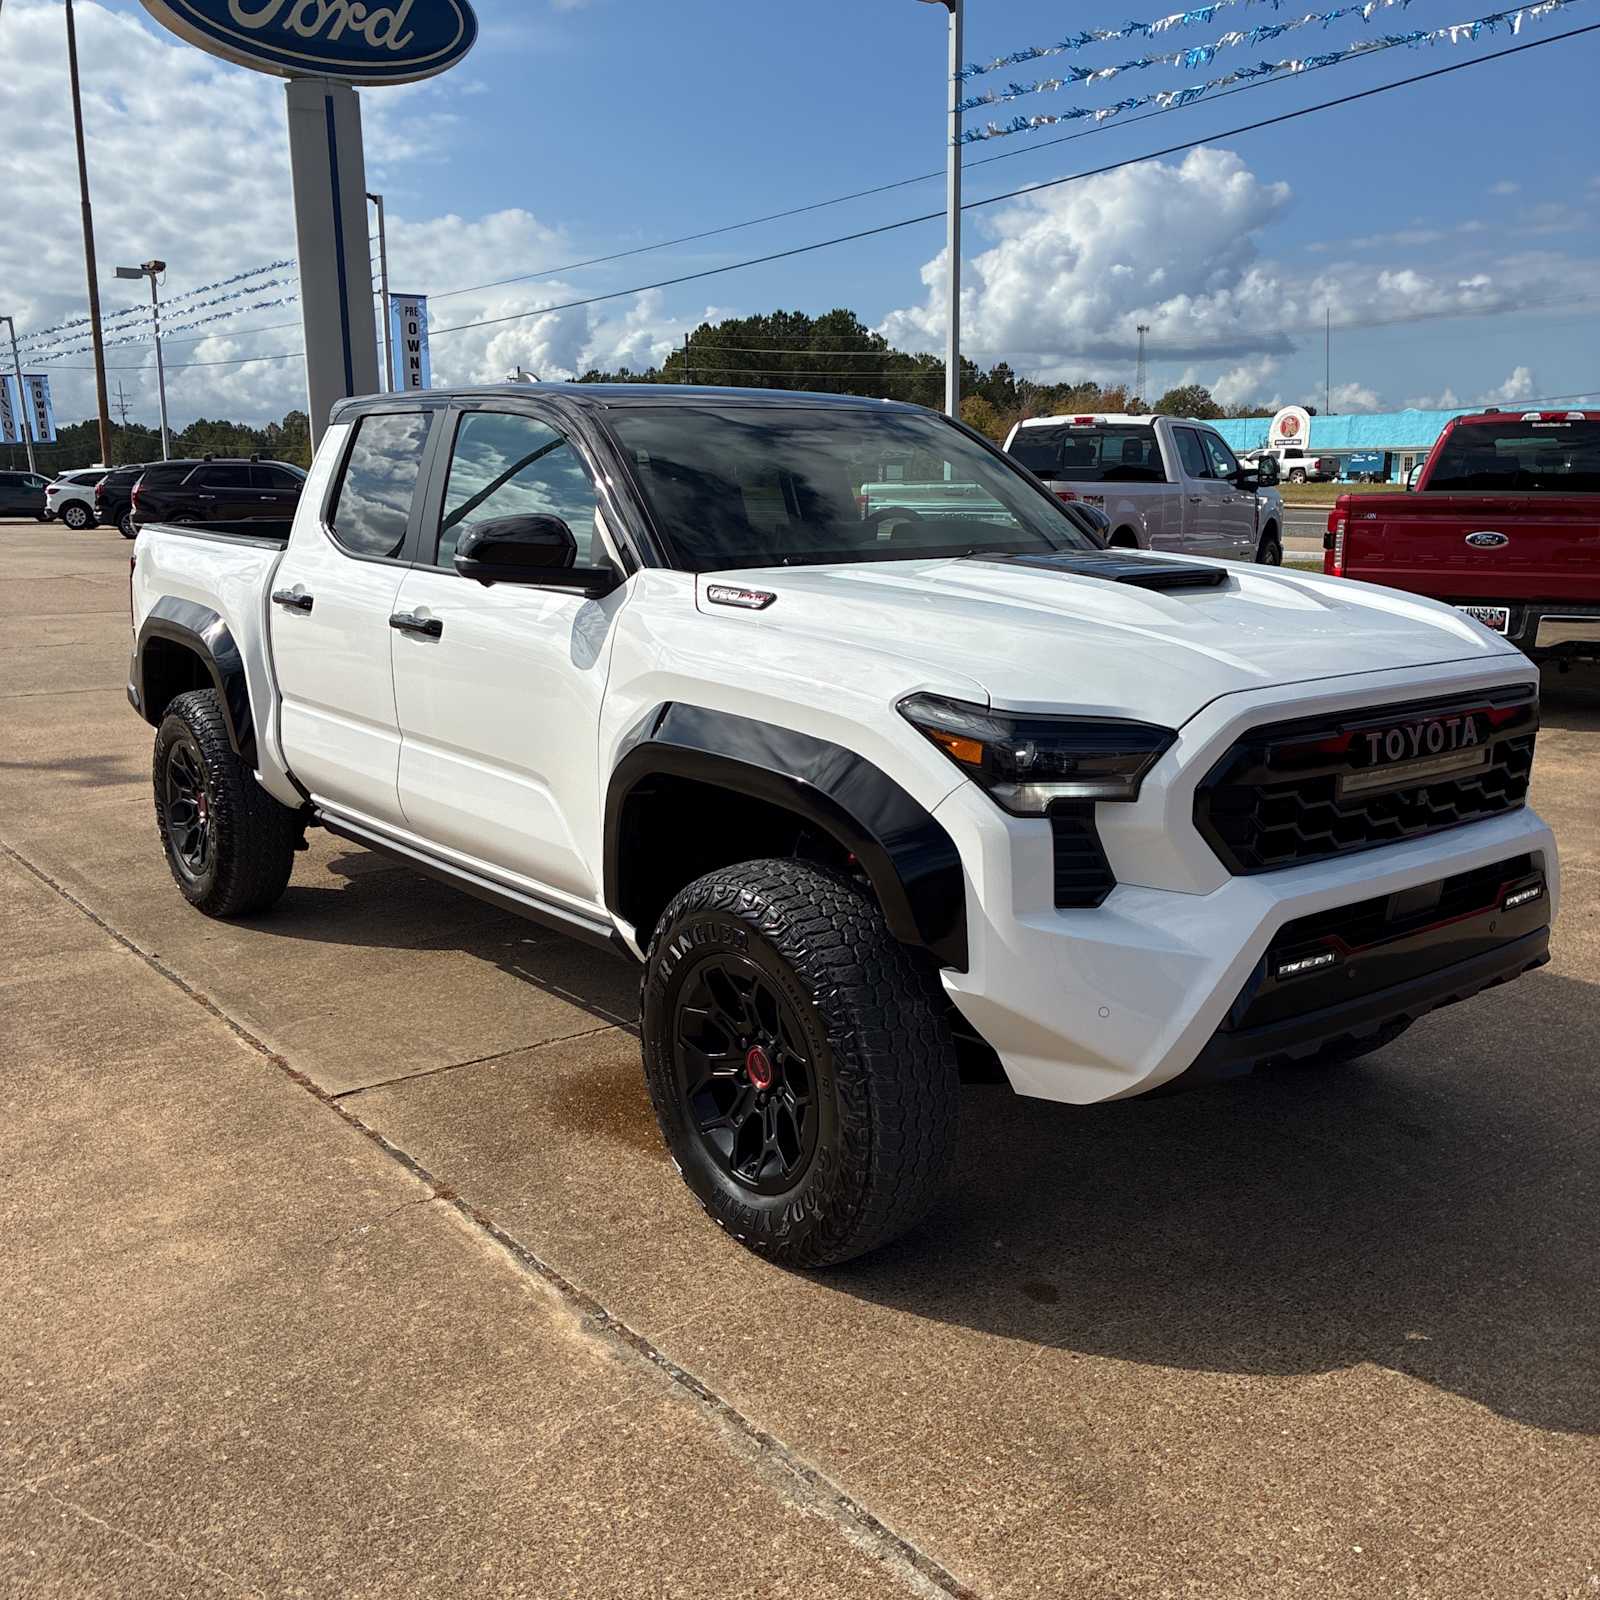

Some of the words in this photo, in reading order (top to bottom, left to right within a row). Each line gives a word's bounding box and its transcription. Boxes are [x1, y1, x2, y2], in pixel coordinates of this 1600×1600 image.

[404, 306, 419, 317] PRE
[407, 321, 420, 387] OWNE
[35, 390, 48, 439] OWNED
[1365, 716, 1479, 766] TOYOTA
